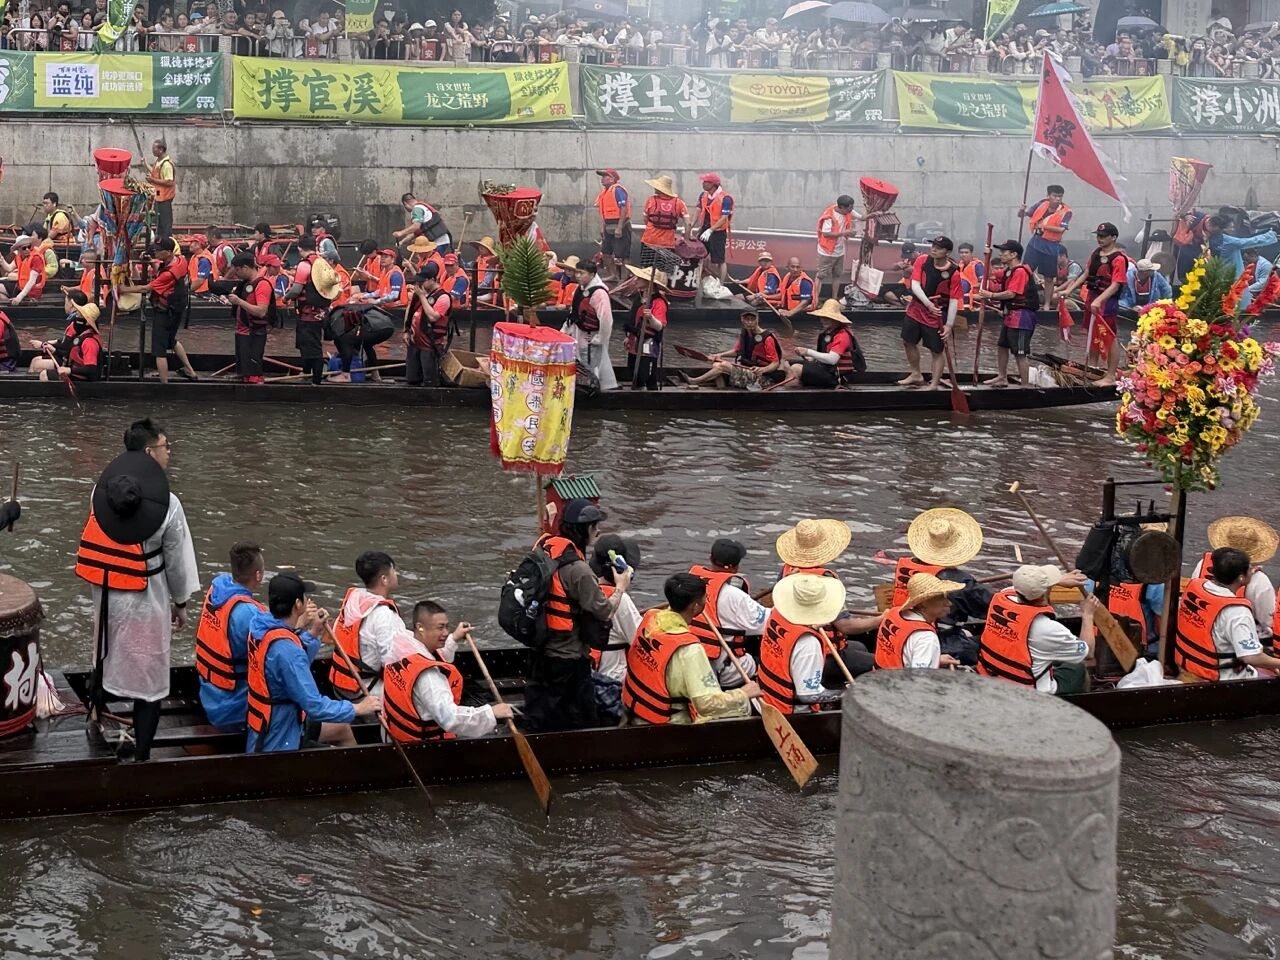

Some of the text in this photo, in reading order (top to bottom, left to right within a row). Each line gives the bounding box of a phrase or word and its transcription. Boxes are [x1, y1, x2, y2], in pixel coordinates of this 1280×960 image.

[52, 74, 94, 95] 蓝纯
[257, 67, 383, 115] 撑宦溪
[598, 71, 712, 119] 撑土华
[768, 85, 811, 95] TOYOTA
[424, 92, 489, 110] 龙之荒野
